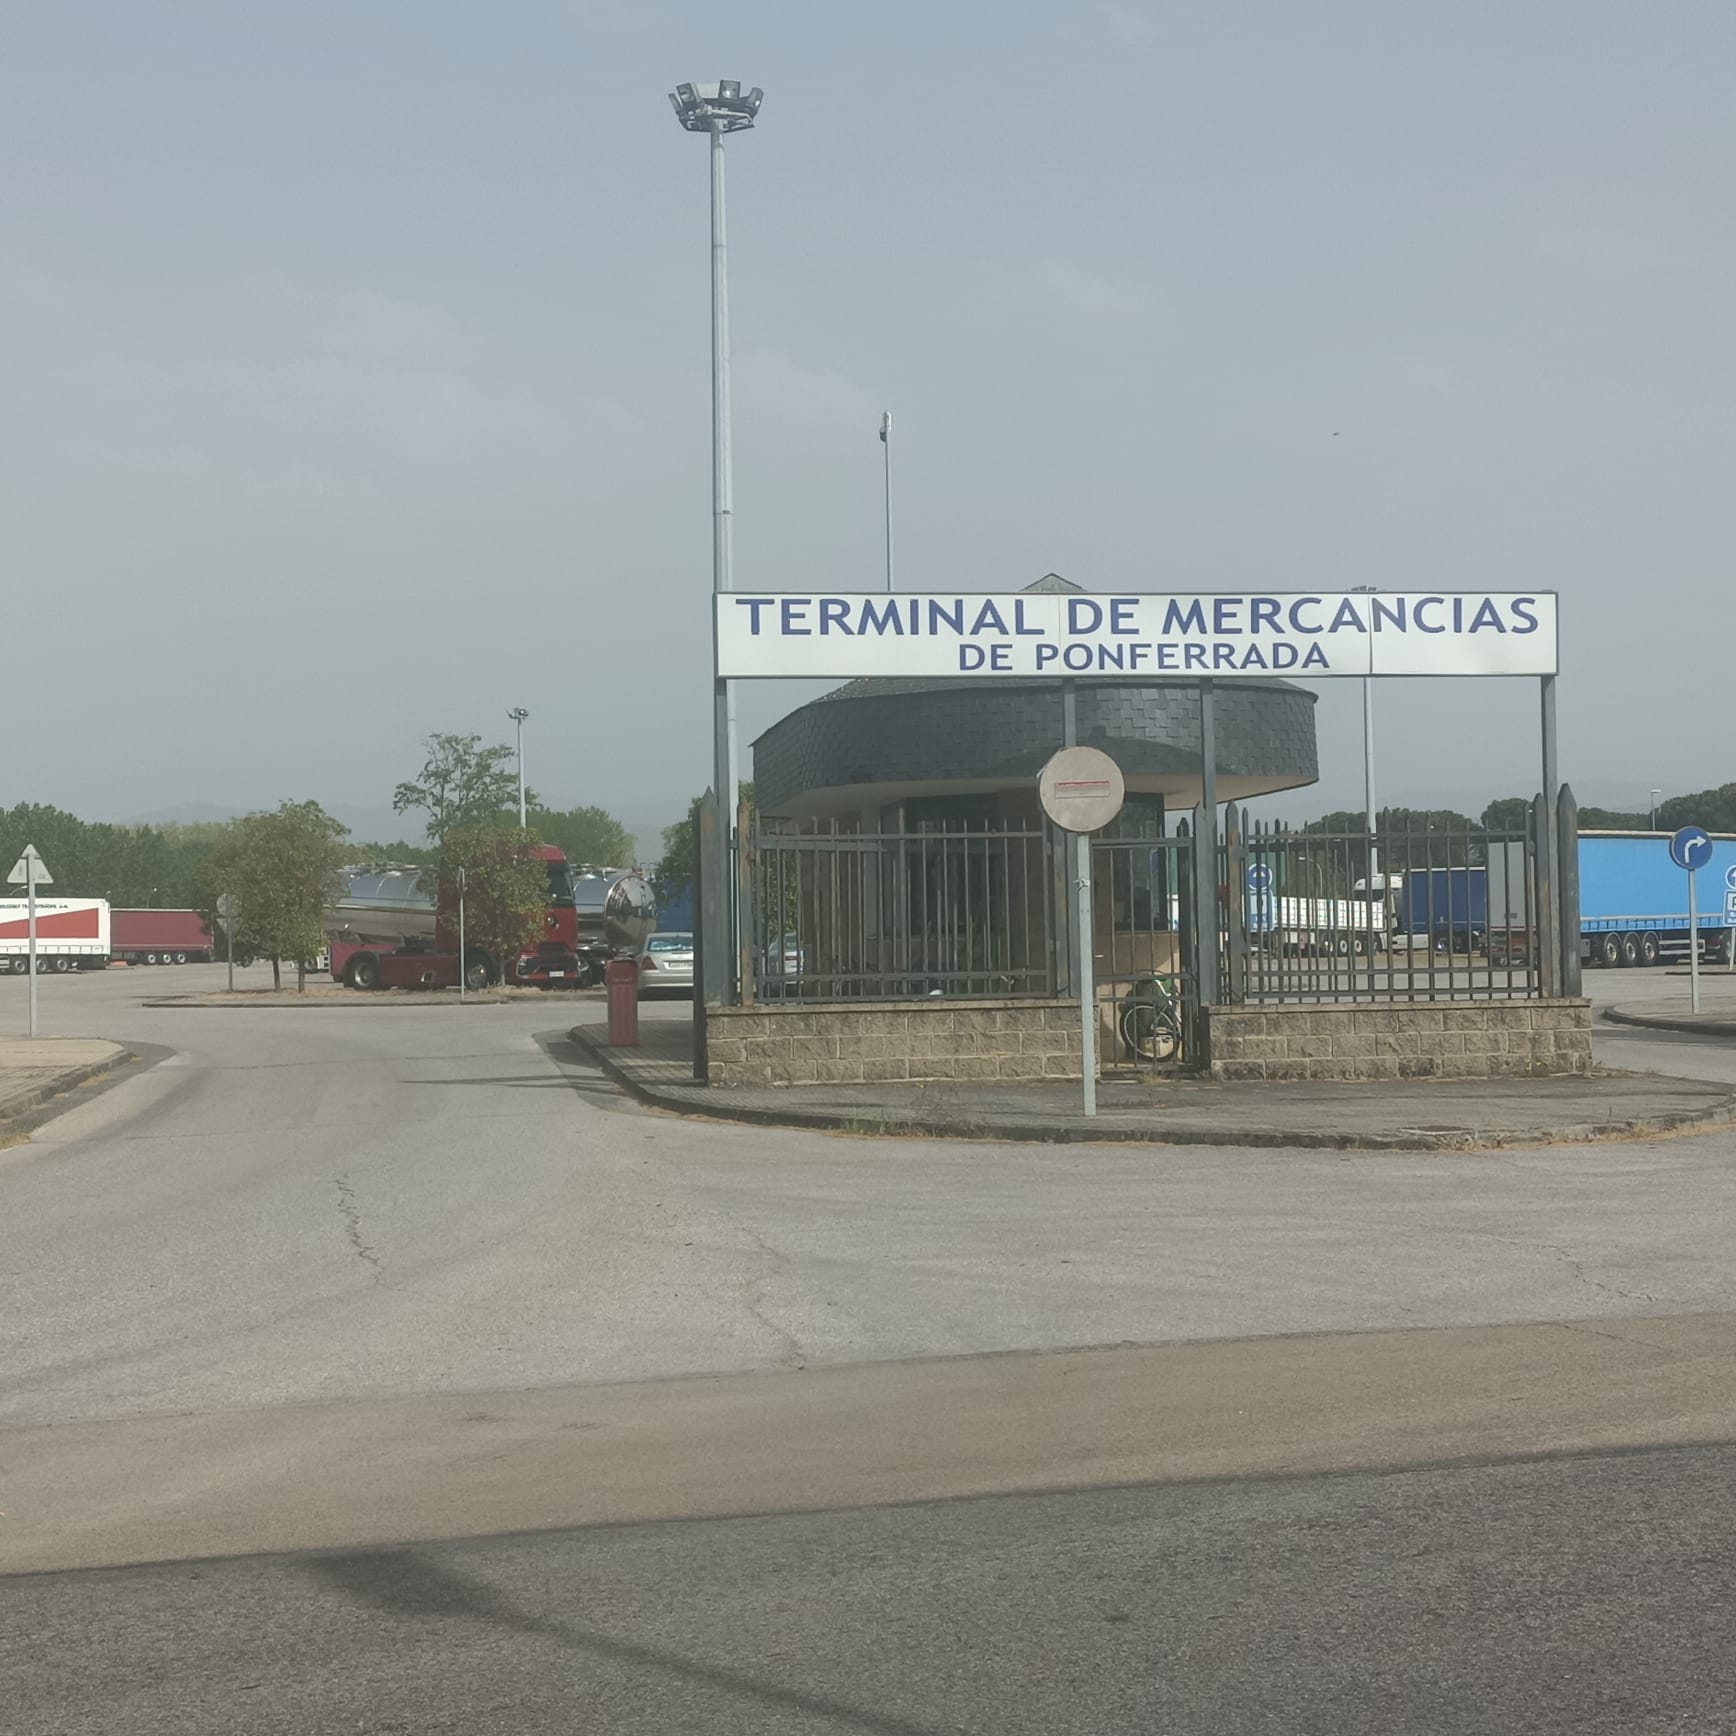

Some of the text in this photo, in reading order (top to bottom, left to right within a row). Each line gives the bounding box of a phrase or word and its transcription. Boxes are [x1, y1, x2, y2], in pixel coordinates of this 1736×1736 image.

[735, 596, 1540, 636] TERMINAL DE MERCANCIAS
[958, 641, 1331, 672] DE PONFERRADA
